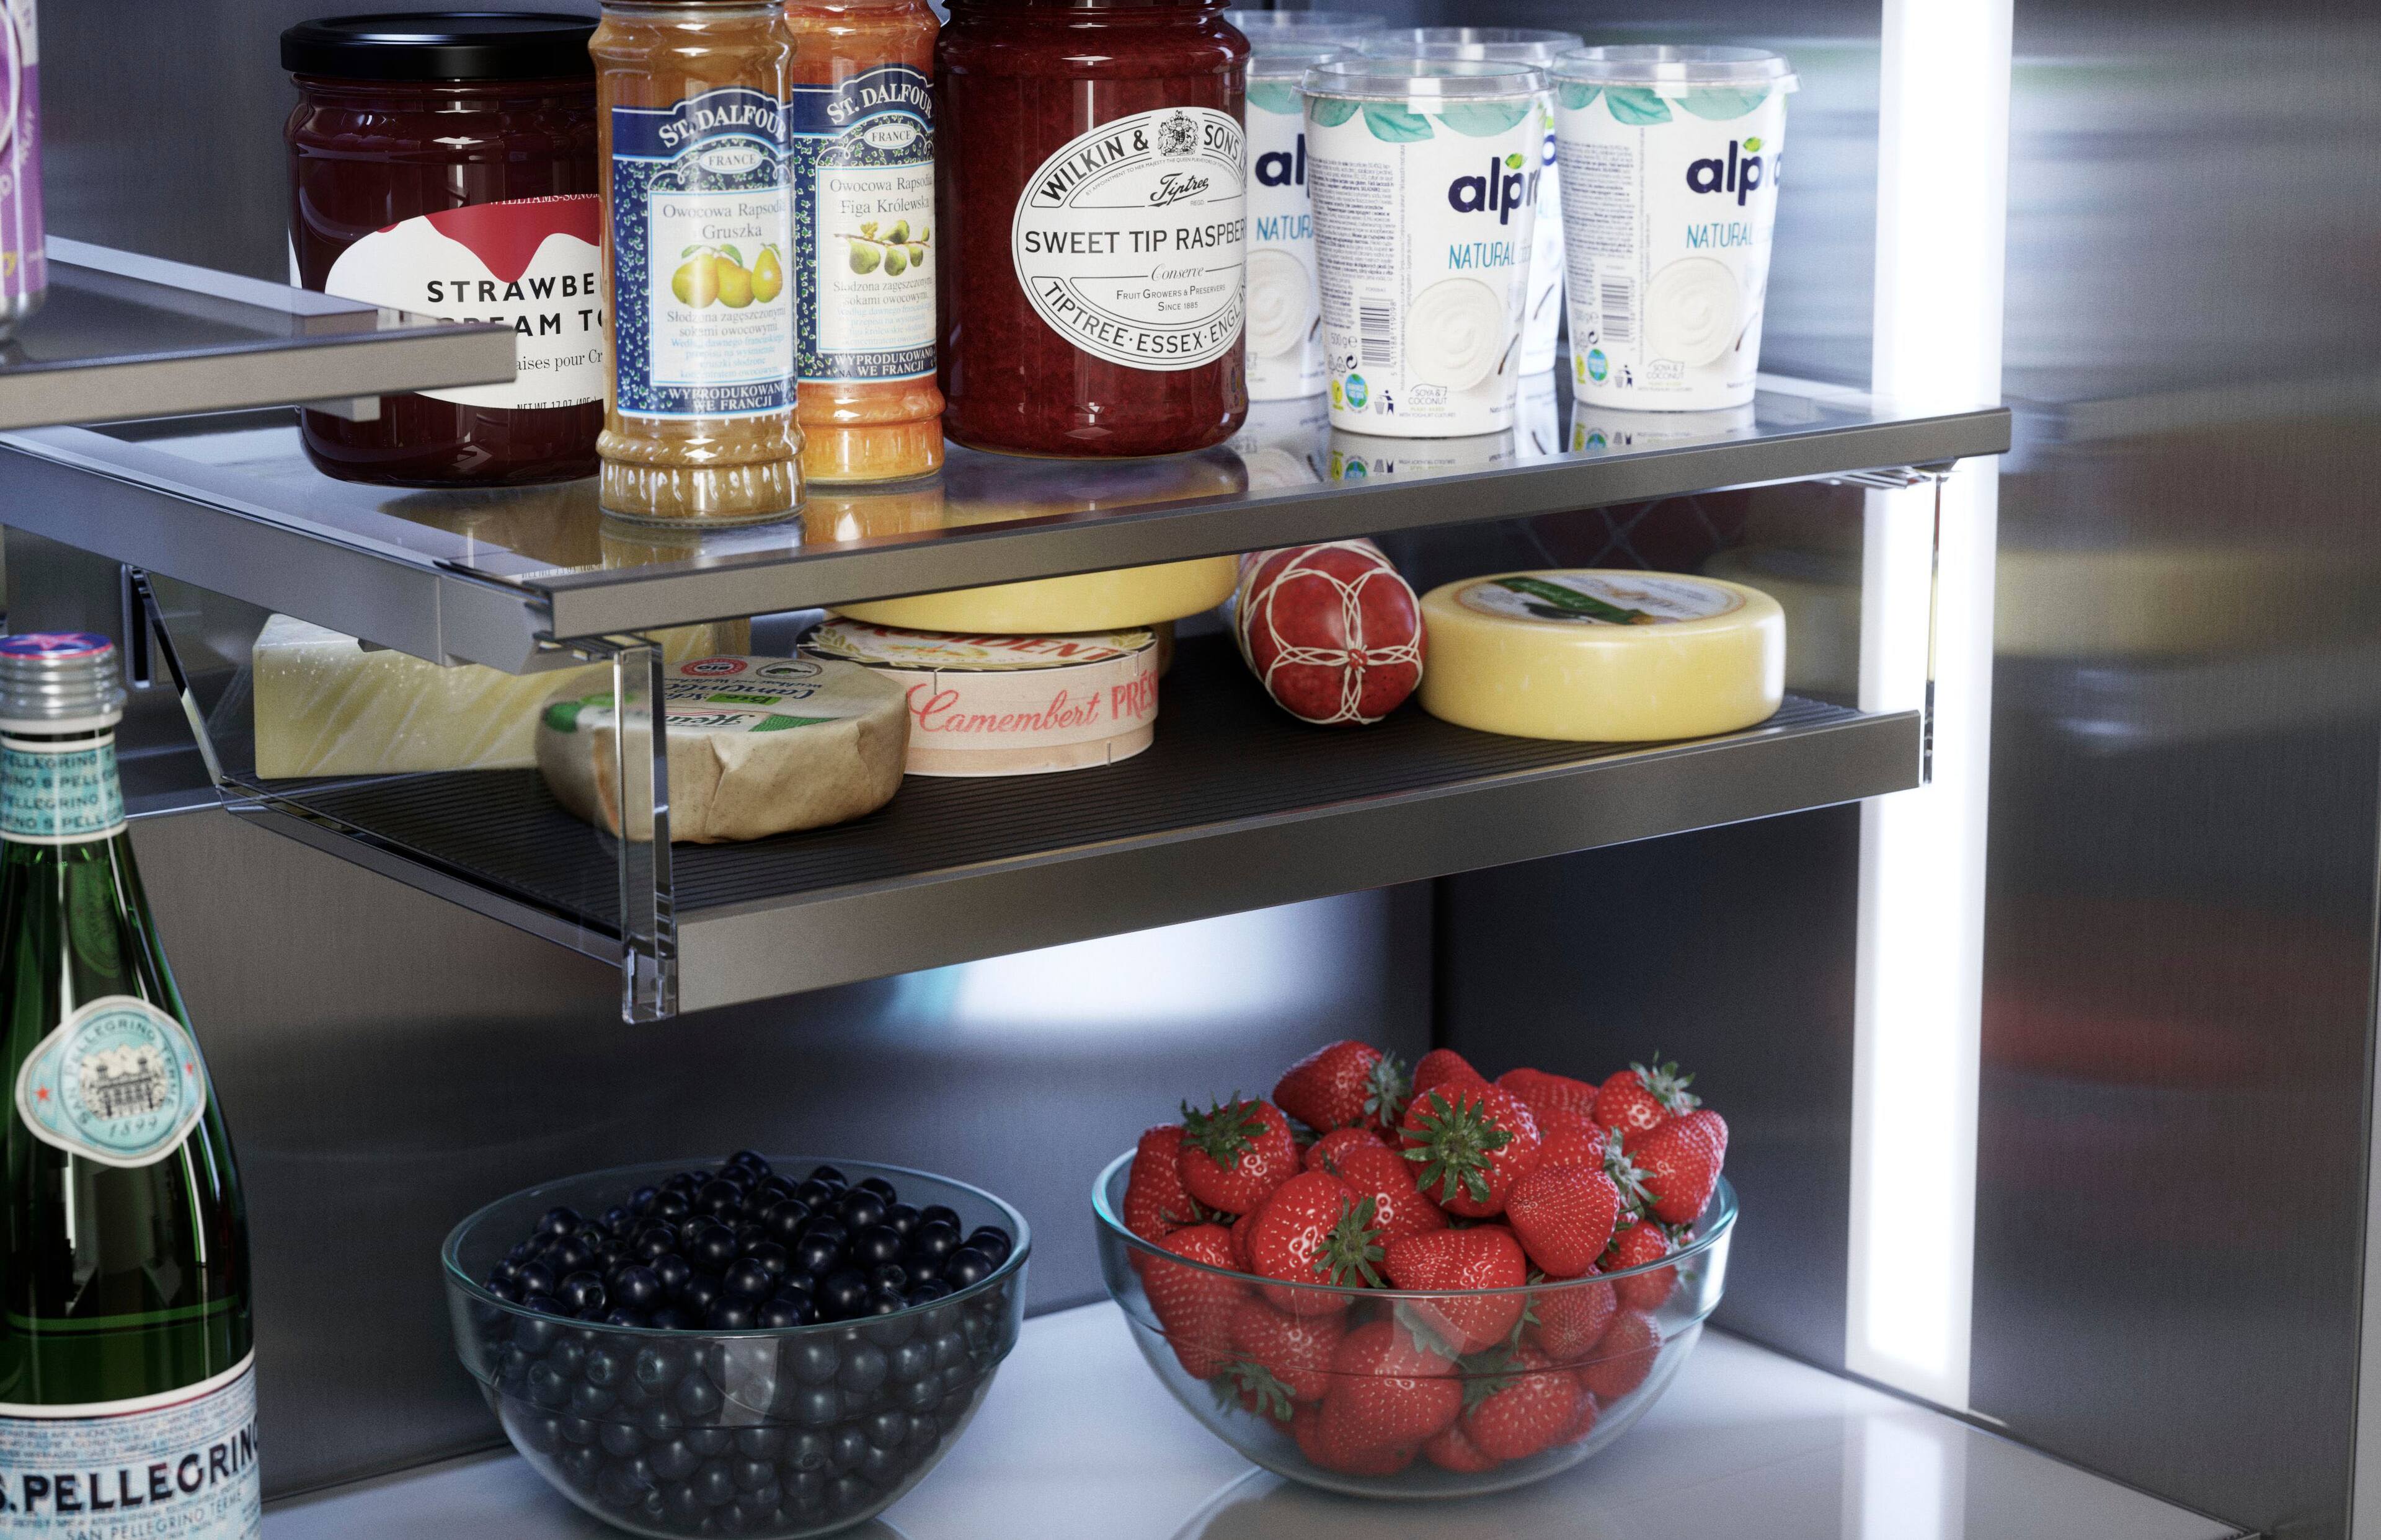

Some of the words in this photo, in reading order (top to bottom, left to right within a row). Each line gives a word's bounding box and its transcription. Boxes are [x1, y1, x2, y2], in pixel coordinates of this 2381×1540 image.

[827, 97, 860, 125] ST.
[860, 83, 933, 119] DALFOUR
[658, 116, 695, 148] ST.
[696, 105, 786, 140] DALFOUR
[872, 130, 912, 142] FRANCE
[709, 153, 756, 167] FRANCE
[1040, 136, 1125, 201] WILKIN
[1133, 129, 1150, 151] &
[1204, 125, 1239, 161] SONS
[1255, 133, 1310, 199] al
[830, 179, 892, 192] Owocowa
[1093, 170, 1126, 191] APPOINTMENT
[1135, 163, 1145, 171] HER
[1145, 158, 1166, 168] MAJESTY
[1148, 172, 1209, 207] Tiptree
[663, 203, 732, 218] Owocowa
[841, 200, 871, 215] Figa
[877, 195, 930, 214] Królewska
[702, 223, 763, 240] Gruszka
[1025, 230, 1120, 255] SWEET
[1129, 229, 1168, 253] TIP
[1176, 219, 1246, 250] RASPBER
[1256, 214, 1314, 241] NATUR
[1686, 223, 1754, 249] NATURAL
[1448, 241, 1515, 270] NATURAL
[1151, 263, 1205, 282] Conserve
[427, 272, 601, 303] STRAWBE
[1044, 281, 1131, 347] TIPTREE
[1137, 330, 1203, 353] ESSEX
[1184, 301, 1199, 309] 1885
[578, 309, 602, 331] T
[516, 358, 550, 371] aises
[554, 354, 585, 372] pour
[588, 348, 603, 363] Cr
[835, 348, 933, 366] WYPRODUKOWANO
[858, 366, 878, 377] WE
[883, 361, 924, 376] FRANCJI
[693, 400, 716, 411] WE
[721, 396, 773, 410] FRANCJI
[1408, 397, 1447, 405] COCONUT
[907, 681, 1101, 734] Camembert
[1111, 668, 1158, 720] PRÉS
